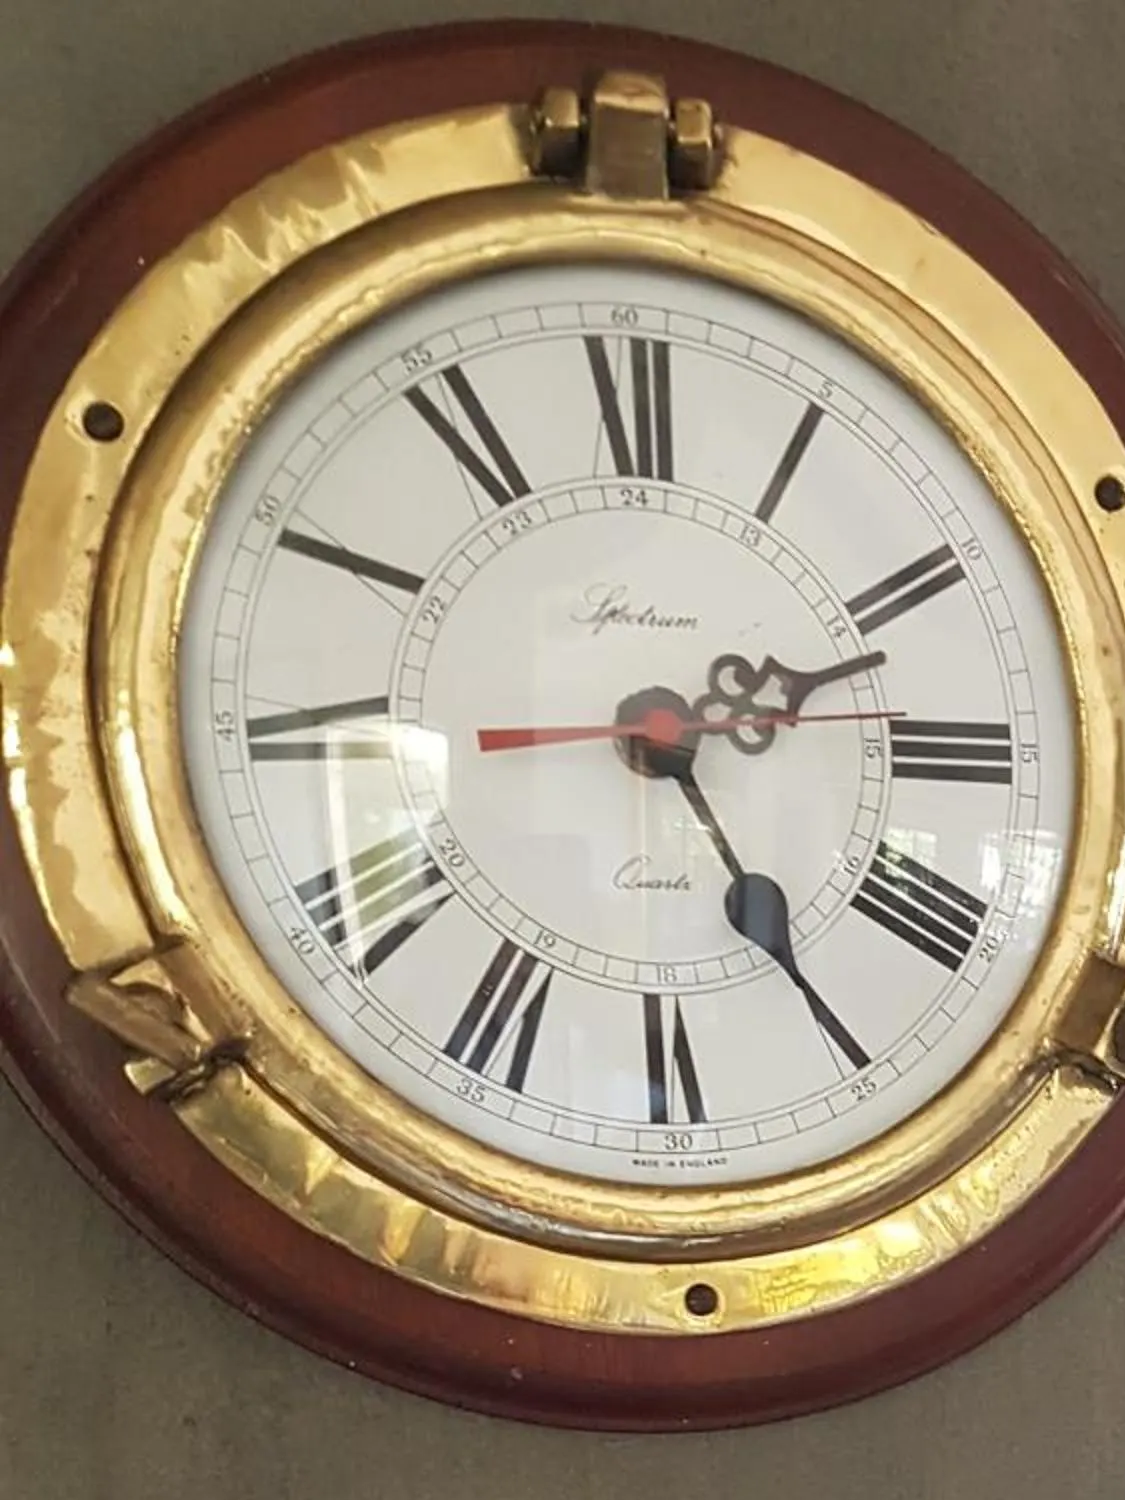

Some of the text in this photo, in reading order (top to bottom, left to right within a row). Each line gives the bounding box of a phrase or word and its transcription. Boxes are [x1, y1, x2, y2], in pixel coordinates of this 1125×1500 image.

[611, 308, 639, 327] 60
[403, 348, 433, 373] 55
[816, 381, 834, 400] 5
[582, 334, 673, 482] XII
[403, 364, 533, 520] XI
[620, 488, 651, 508] 24
[254, 495, 281, 529] 50
[502, 511, 533, 537] 23
[737, 525, 762, 548] 13
[961, 537, 984, 562] 10
[277, 508, 427, 619] X
[844, 543, 967, 636] II
[422, 595, 448, 624] 22
[569, 582, 699, 635] Spectrum
[826, 616, 848, 640] 14
[216, 711, 234, 742] 45
[245, 695, 392, 761] IX
[863, 737, 881, 760] 15
[890, 719, 1012, 785] III
[1020, 742, 1039, 764] 15
[439, 838, 465, 867] 20
[288, 925, 315, 956] 40
[534, 930, 557, 948] 19
[979, 934, 1002, 964] 20
[657, 964, 678, 983] 18
[444, 938, 553, 1093] VII
[643, 993, 708, 1125] VI
[455, 1077, 487, 1103] 35
[850, 1078, 877, 1103] 25
[664, 1131, 694, 1151] 30
[632, 1158, 659, 1168] MADE
